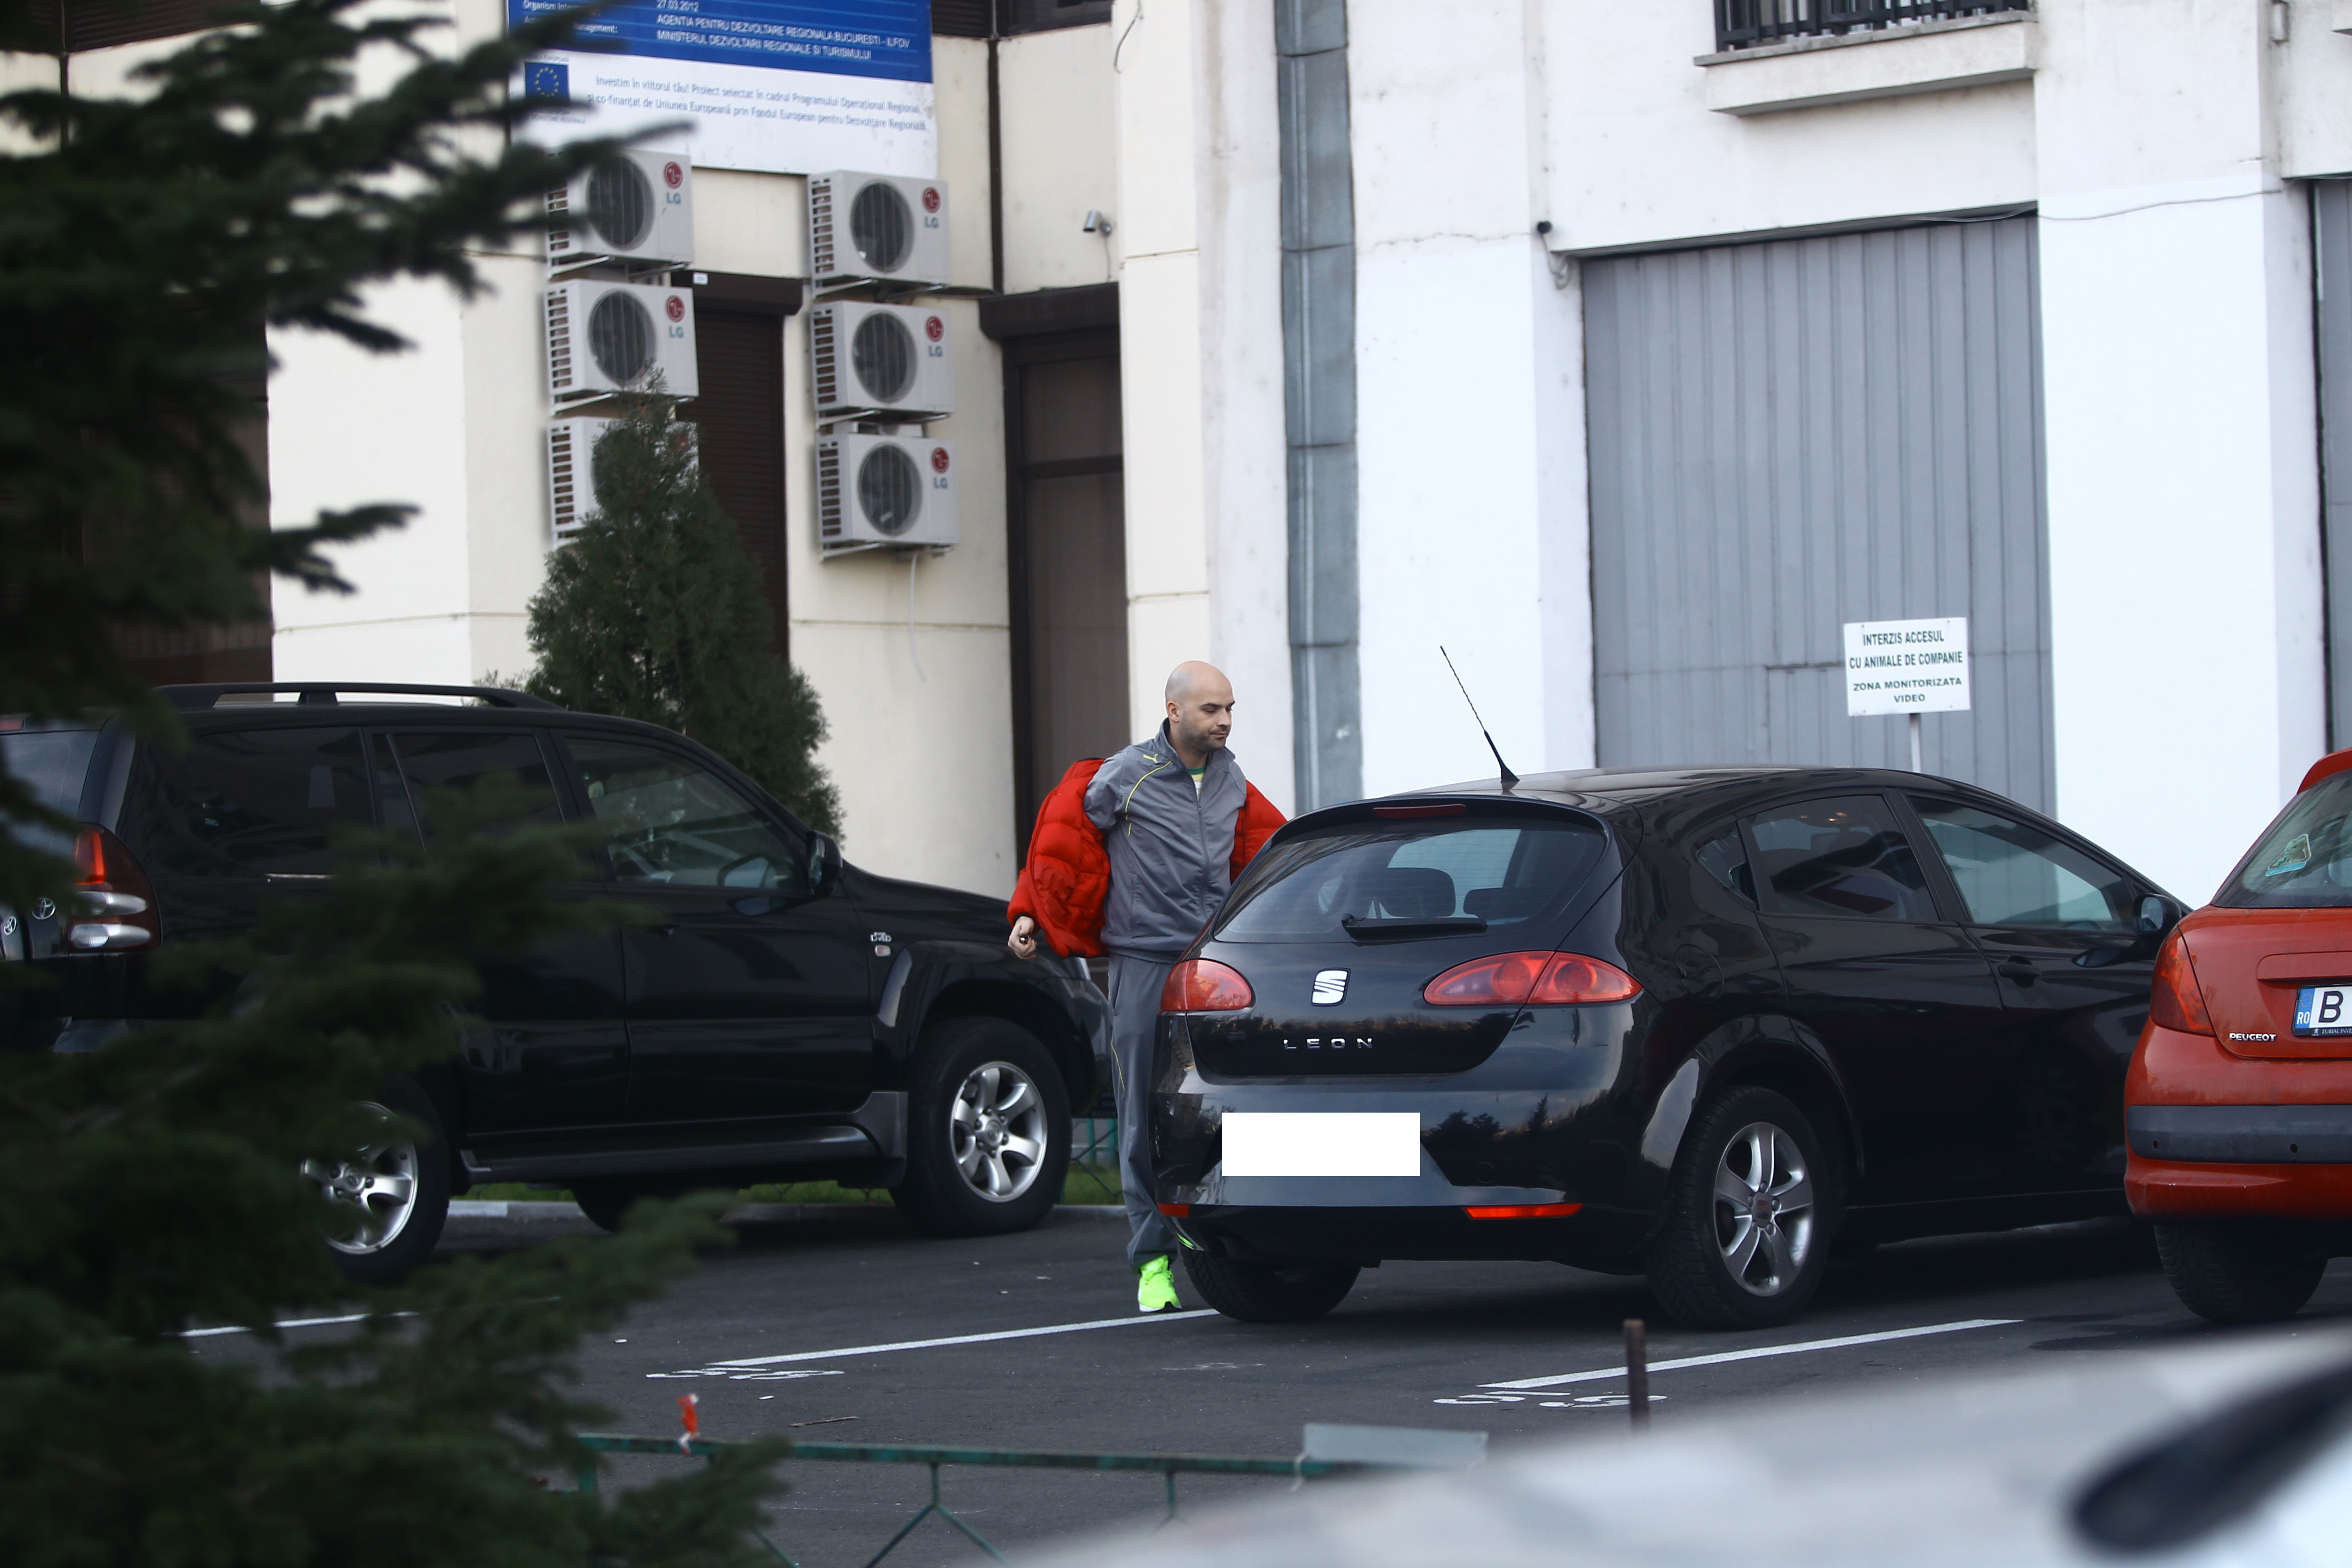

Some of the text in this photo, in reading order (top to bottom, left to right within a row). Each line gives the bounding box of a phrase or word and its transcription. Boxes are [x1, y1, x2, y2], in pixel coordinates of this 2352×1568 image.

[522, 0, 556, 11] Organism
[695, 17, 730, 31] PENTRU
[731, 21, 785, 37] DEZVOLTARE
[785, 26, 834, 40] REGIONALA
[834, 31, 881, 45] BUCURESTI
[887, 37, 910, 48] ILFOV
[657, 29, 708, 45] MINISTERUL
[709, 35, 762, 49] DEZVOLTARII
[763, 39, 811, 54] REGIONALE
[822, 45, 872, 60] TURISMULUI
[597, 75, 630, 87] Investim
[643, 79, 671, 91] viitorul
[792, 92, 839, 107] Programului
[643, 98, 654, 107] de
[656, 98, 688, 110] Uniunea
[751, 106, 777, 118] Fondul
[779, 108, 816, 122] European
[818, 113, 844, 125] pentru
[845, 114, 887, 128] Dezvoltare
[666, 192, 681, 204] LG
[924, 215, 939, 229] LG
[668, 326, 684, 339] LG
[928, 344, 943, 357] LG
[933, 477, 948, 489] LG
[1863, 630, 1944, 646] INTERZIS ACCESUL
[1850, 651, 1963, 669] CU ANIMALE DE COMPANIE
[1853, 677, 1962, 692] ZONA MONITORIZATA
[1894, 694, 1925, 703] VIDEO
[2318, 991, 2343, 1023] B
[2297, 1011, 2310, 1024] RO
[2230, 1033, 2276, 1041] PEUGEOT
[1283, 1038, 1372, 1050] LEON
